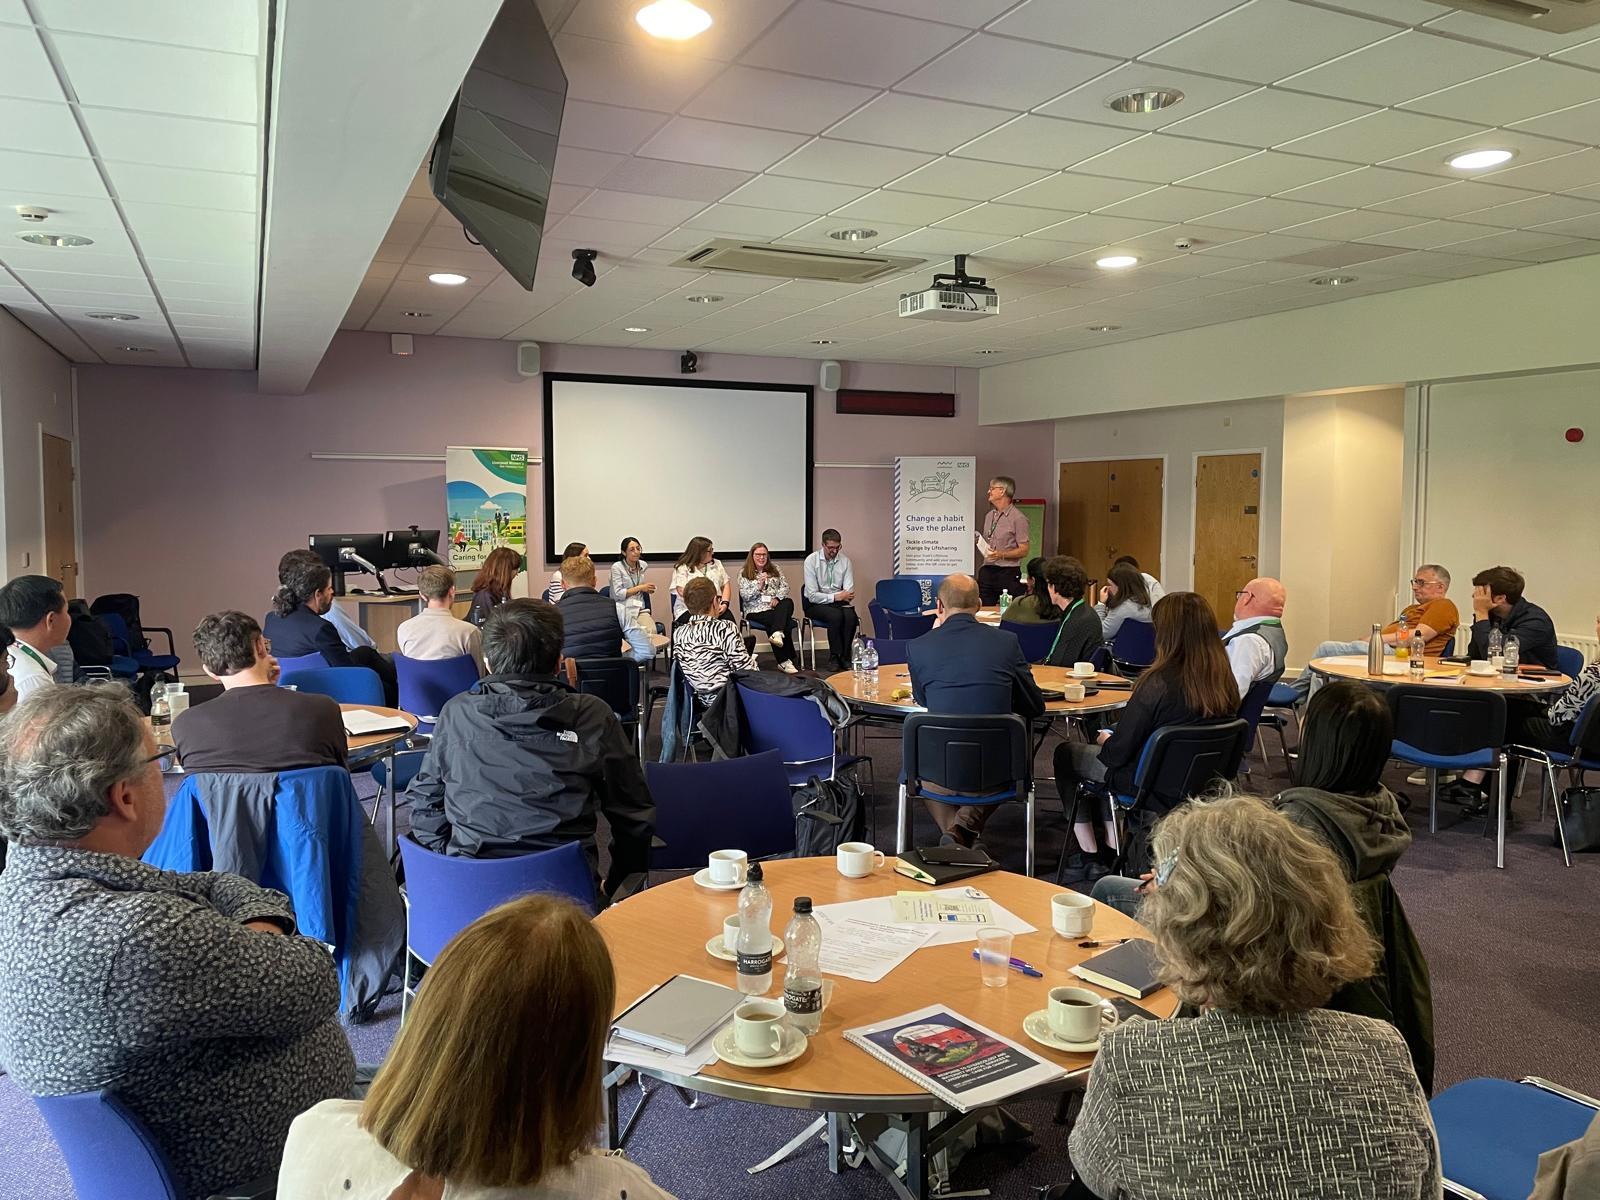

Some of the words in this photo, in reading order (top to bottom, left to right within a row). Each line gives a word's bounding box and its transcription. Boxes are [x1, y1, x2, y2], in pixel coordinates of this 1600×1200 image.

[906, 514, 935, 524] Change
[944, 514, 964, 522] habit
[941, 524, 966, 533] planet
[452, 554, 475, 562] Caring
[743, 957, 771, 965] HARROGA
[785, 993, 807, 1003] ROGATE
